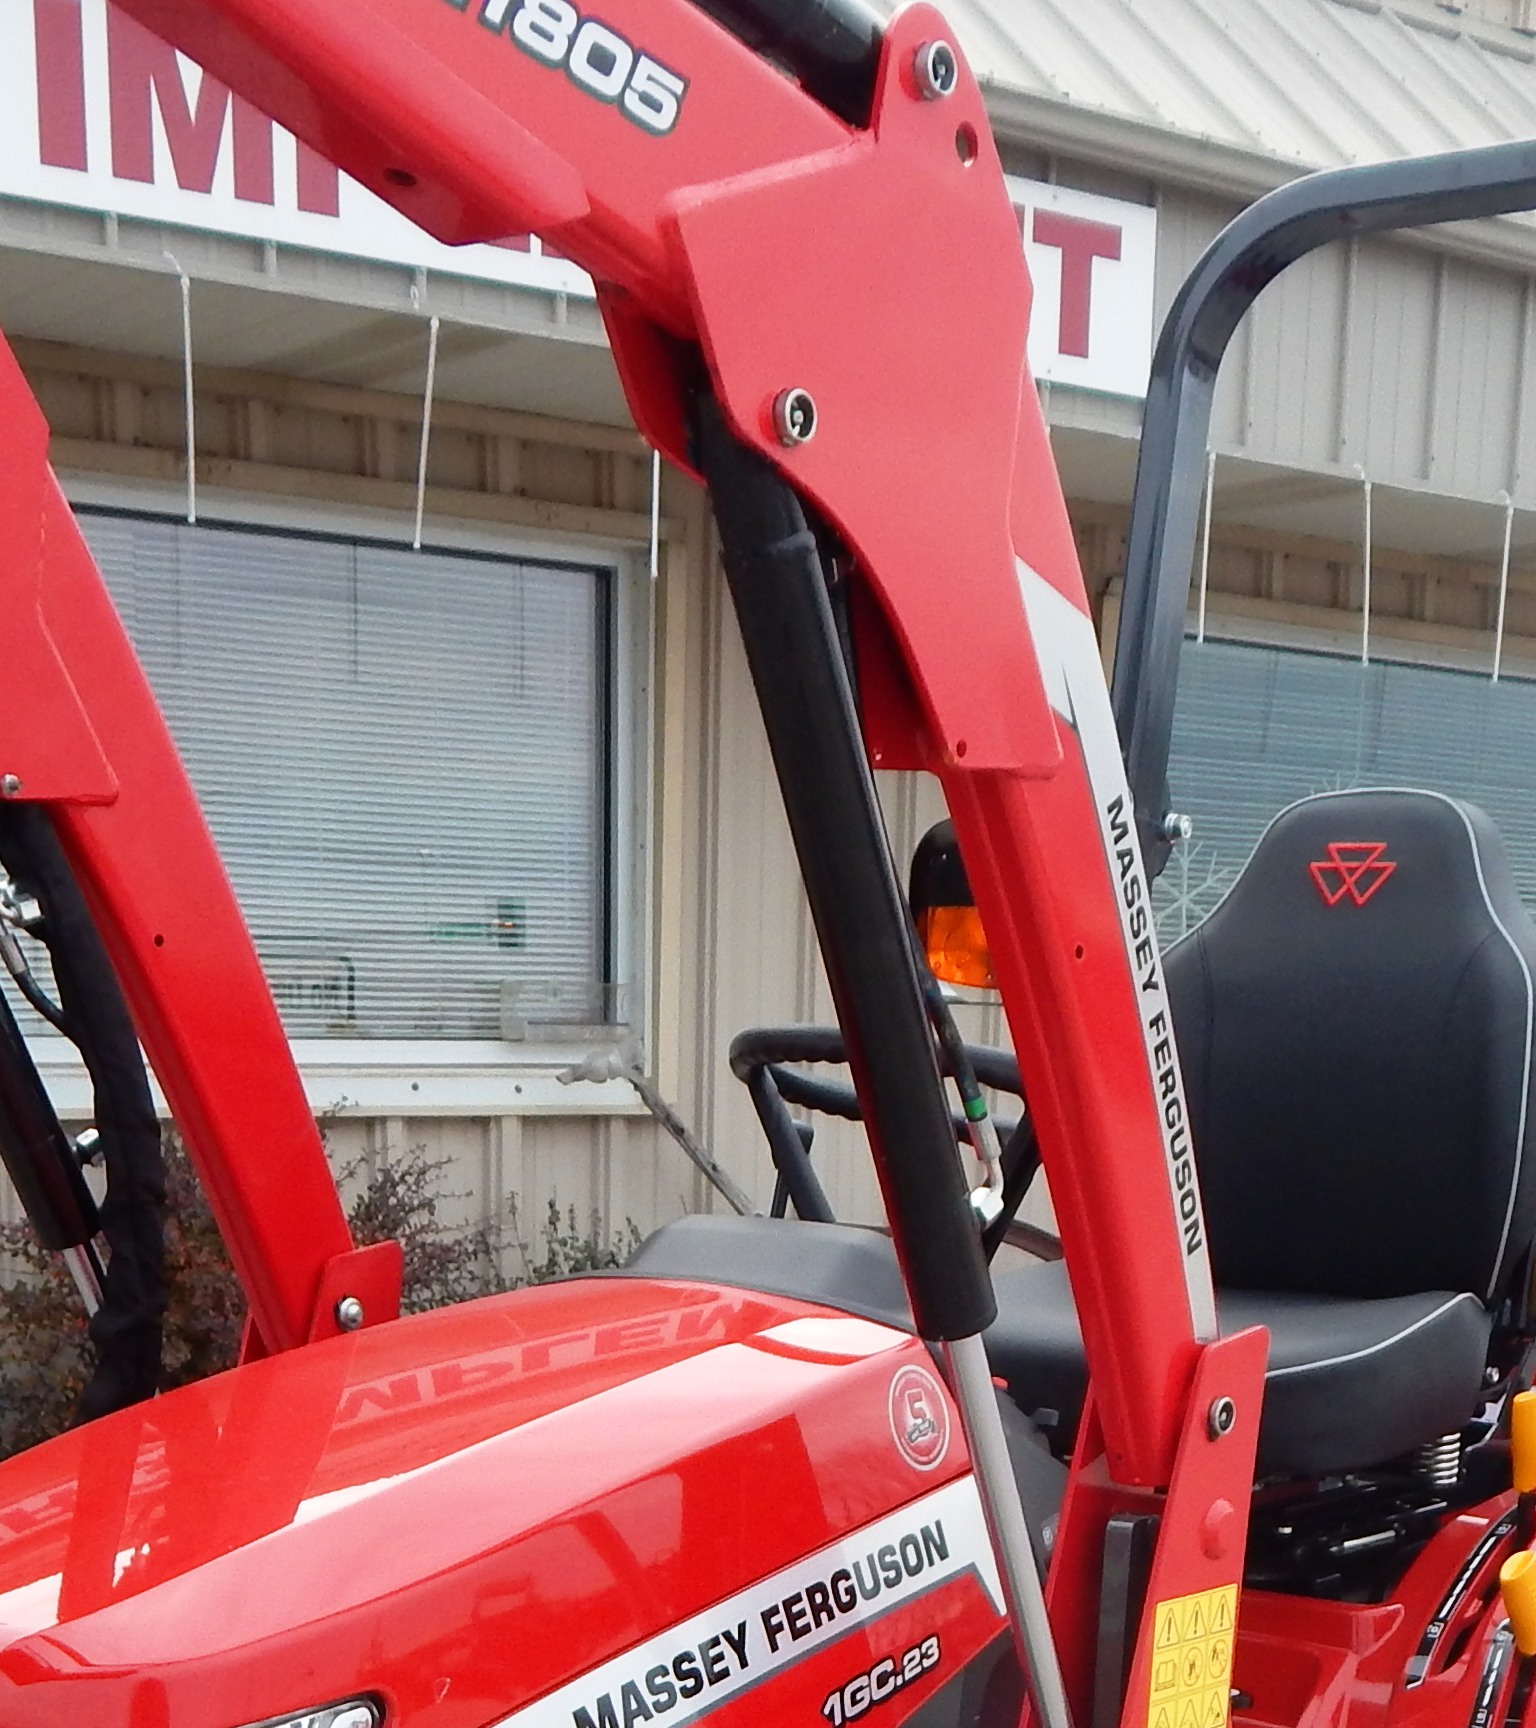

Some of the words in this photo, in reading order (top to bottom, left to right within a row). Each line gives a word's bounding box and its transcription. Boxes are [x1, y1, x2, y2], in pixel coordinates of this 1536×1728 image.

[1106, 793, 1160, 993] MASSEY
[1149, 1008, 1203, 1257] FERGUSON
[760, 1518, 951, 1654] FERGUSON
